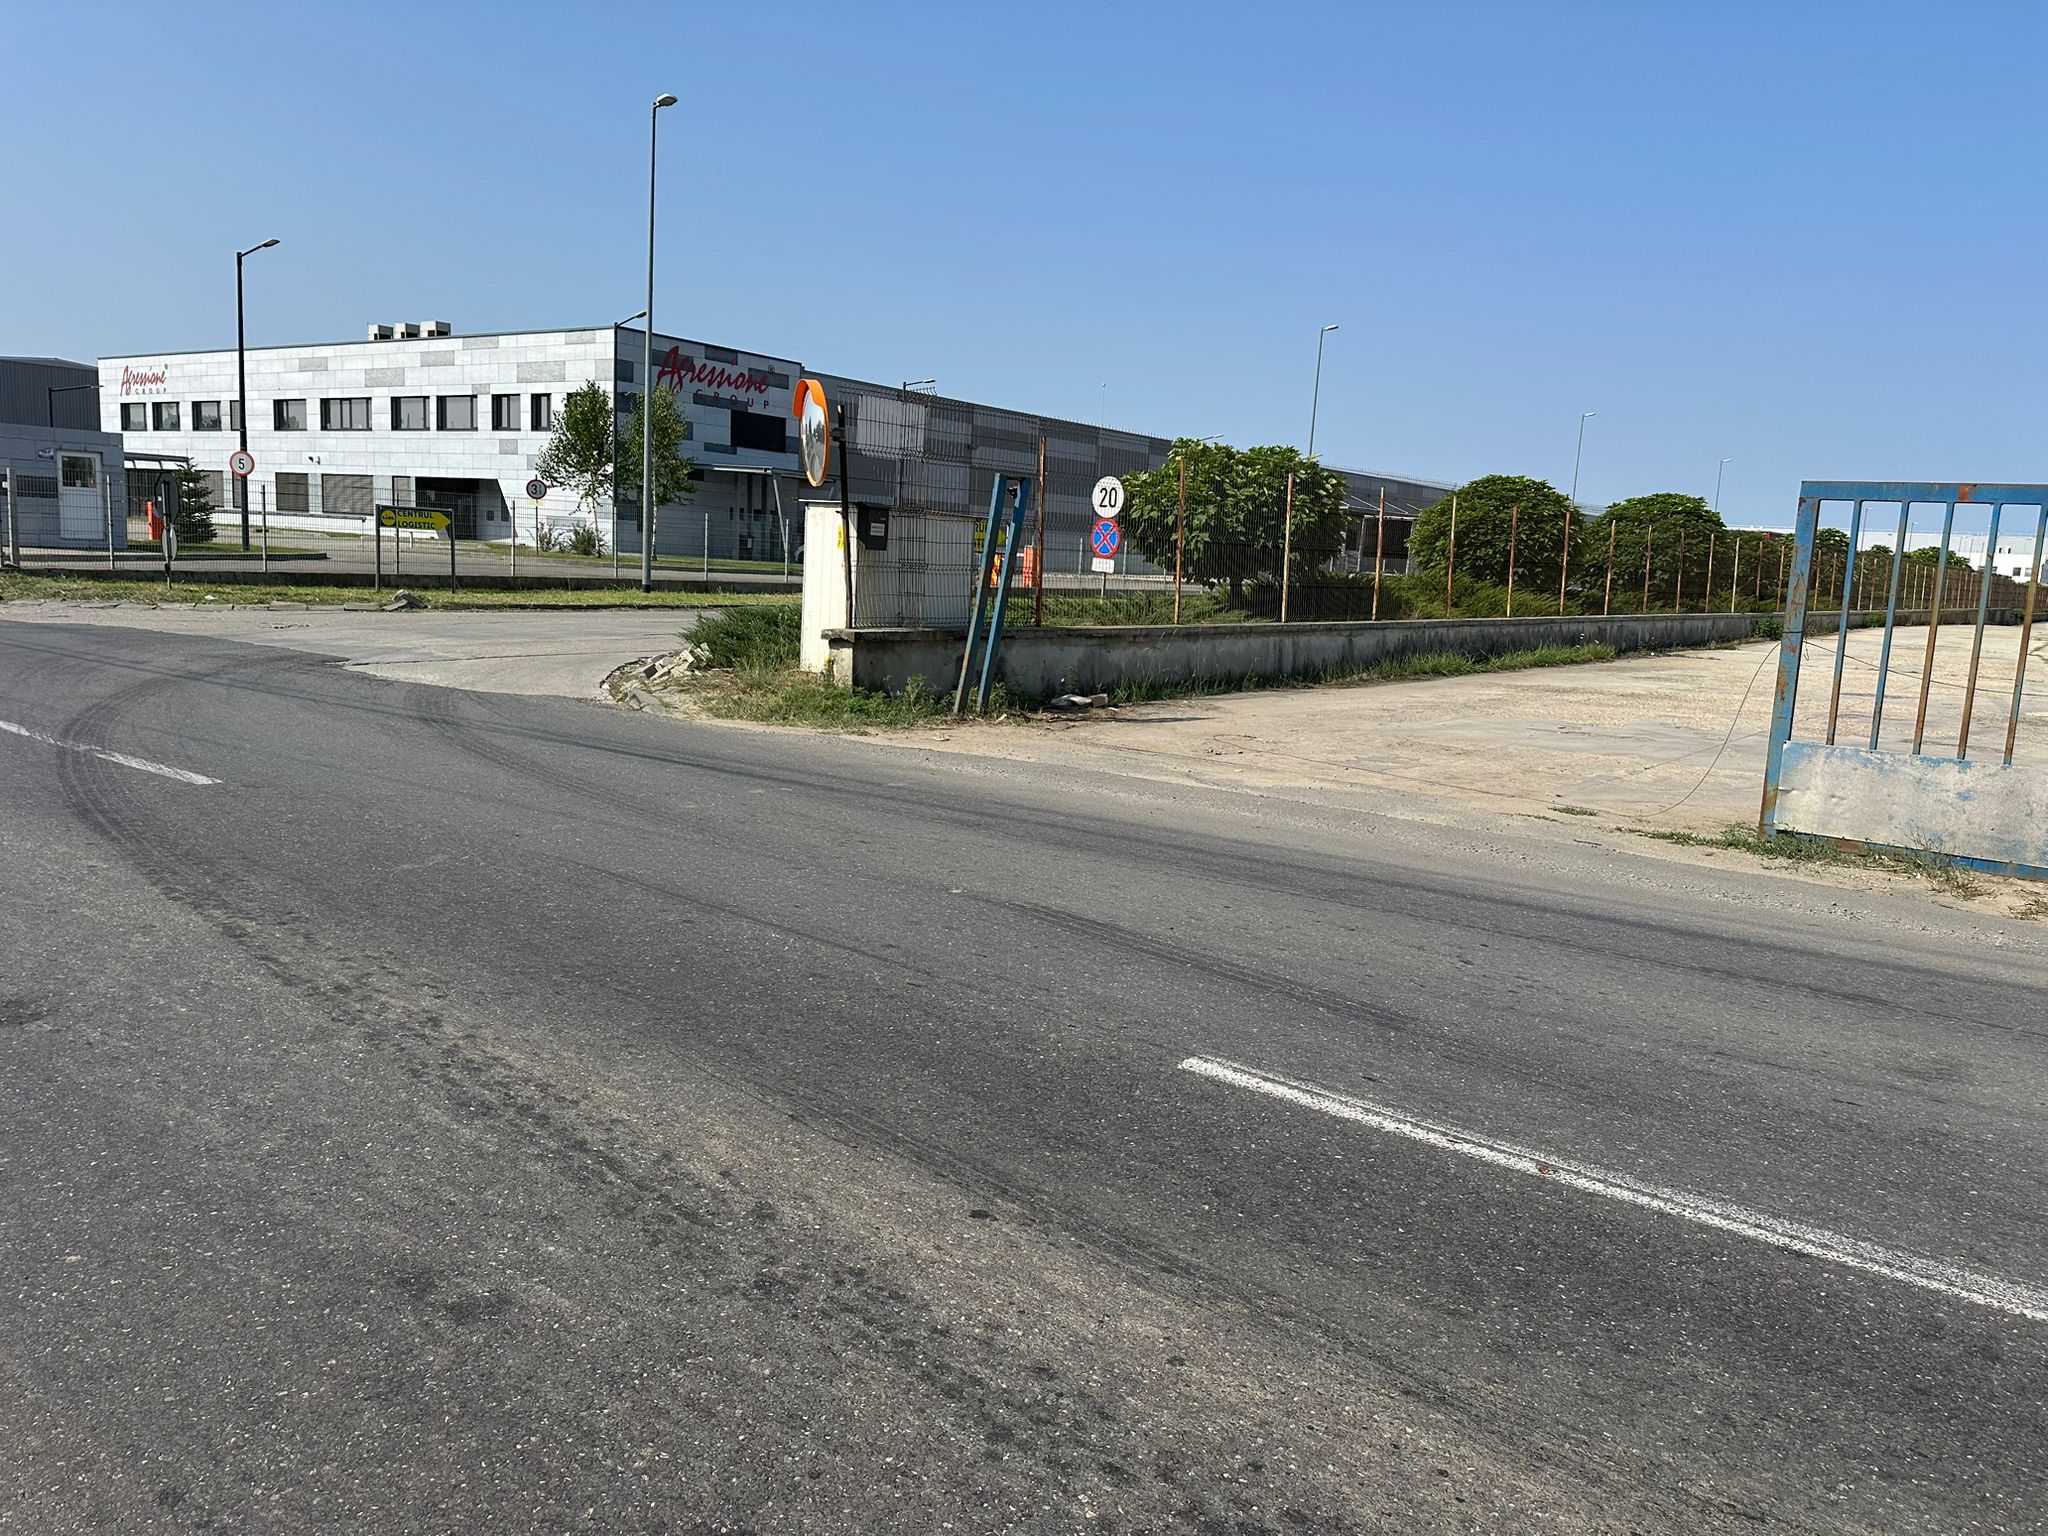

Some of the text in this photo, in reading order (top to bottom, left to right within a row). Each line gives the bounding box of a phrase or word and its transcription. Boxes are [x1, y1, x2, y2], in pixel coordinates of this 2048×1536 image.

[135, 387, 167, 395] GROUP
[695, 389, 769, 409] GROUP
[238, 458, 245, 470] 5
[1099, 487, 1118, 508] 20
[397, 510, 434, 519] CENTRUL
[397, 520, 436, 530] LOGISTIC
